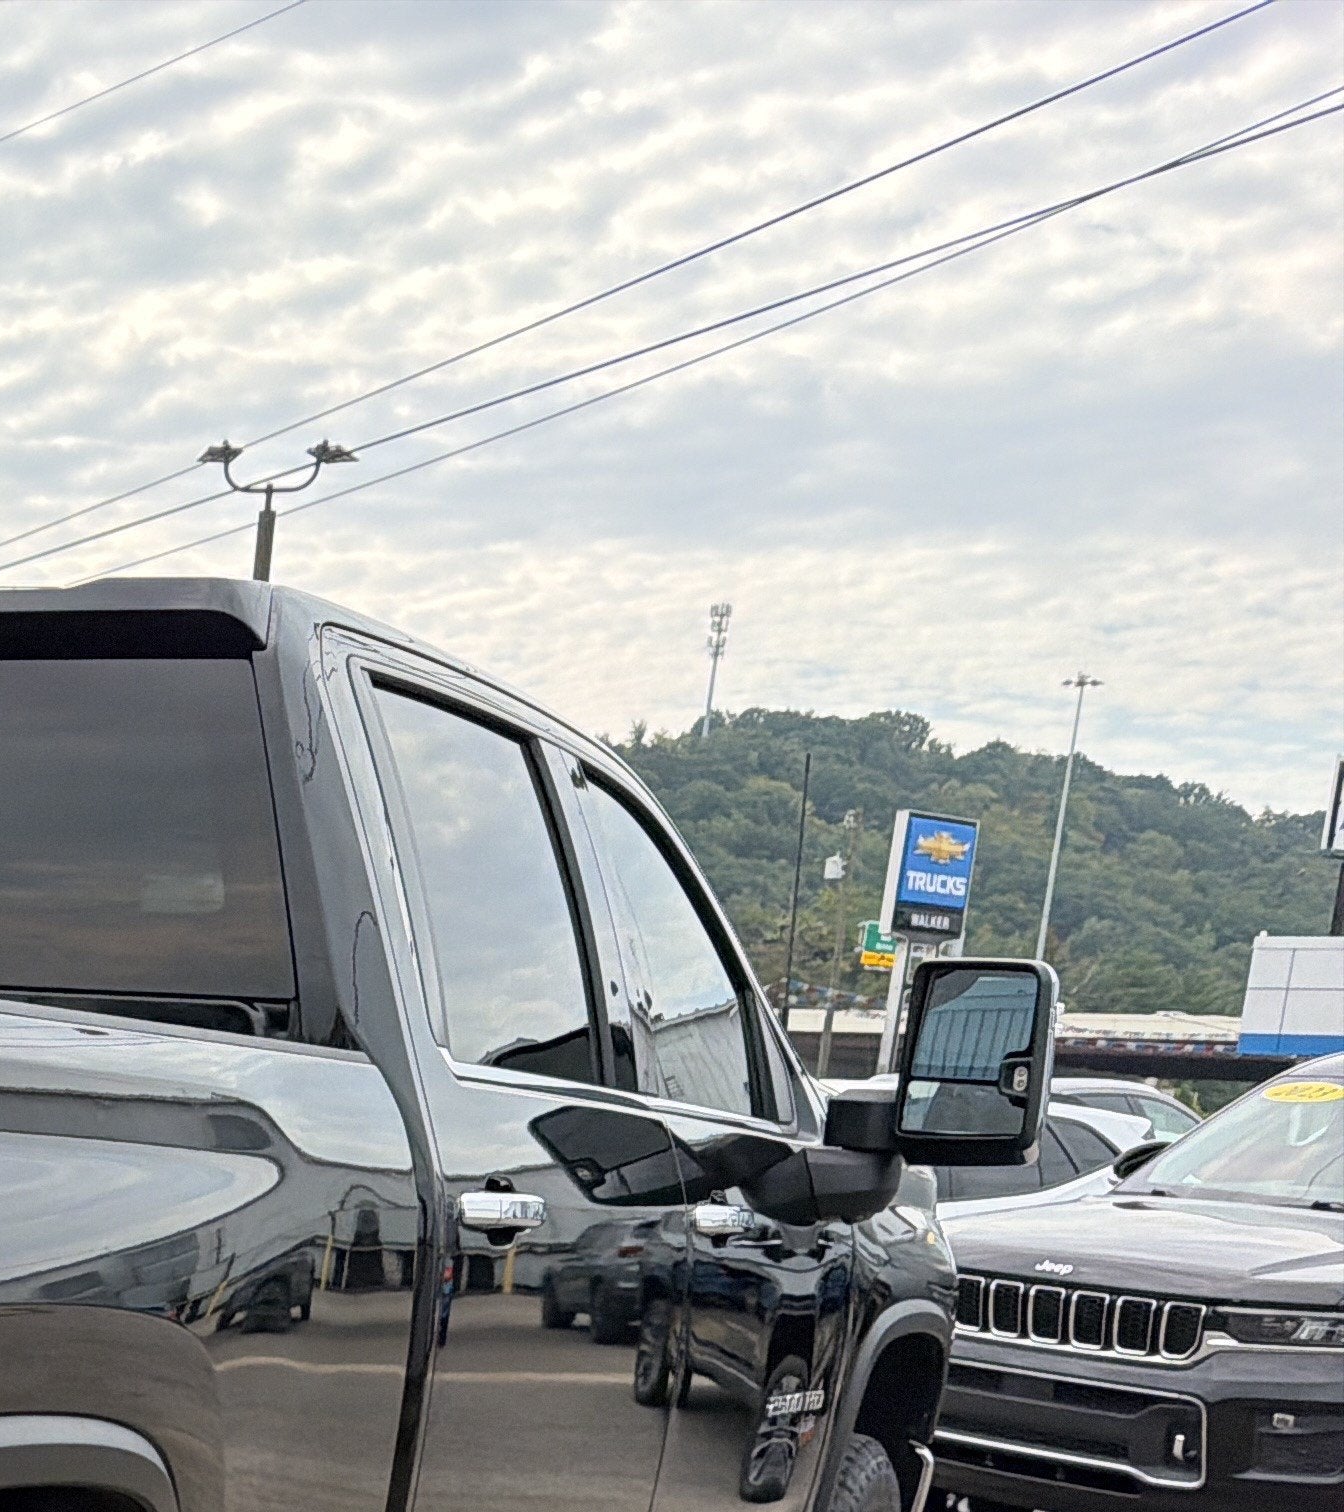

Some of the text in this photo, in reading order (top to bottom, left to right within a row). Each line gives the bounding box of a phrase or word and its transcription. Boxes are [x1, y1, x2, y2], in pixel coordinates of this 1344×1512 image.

[906, 870, 967, 896] TRUCKS
[911, 913, 950, 930] WALKER
[1034, 1259, 1074, 1276] Jeep
